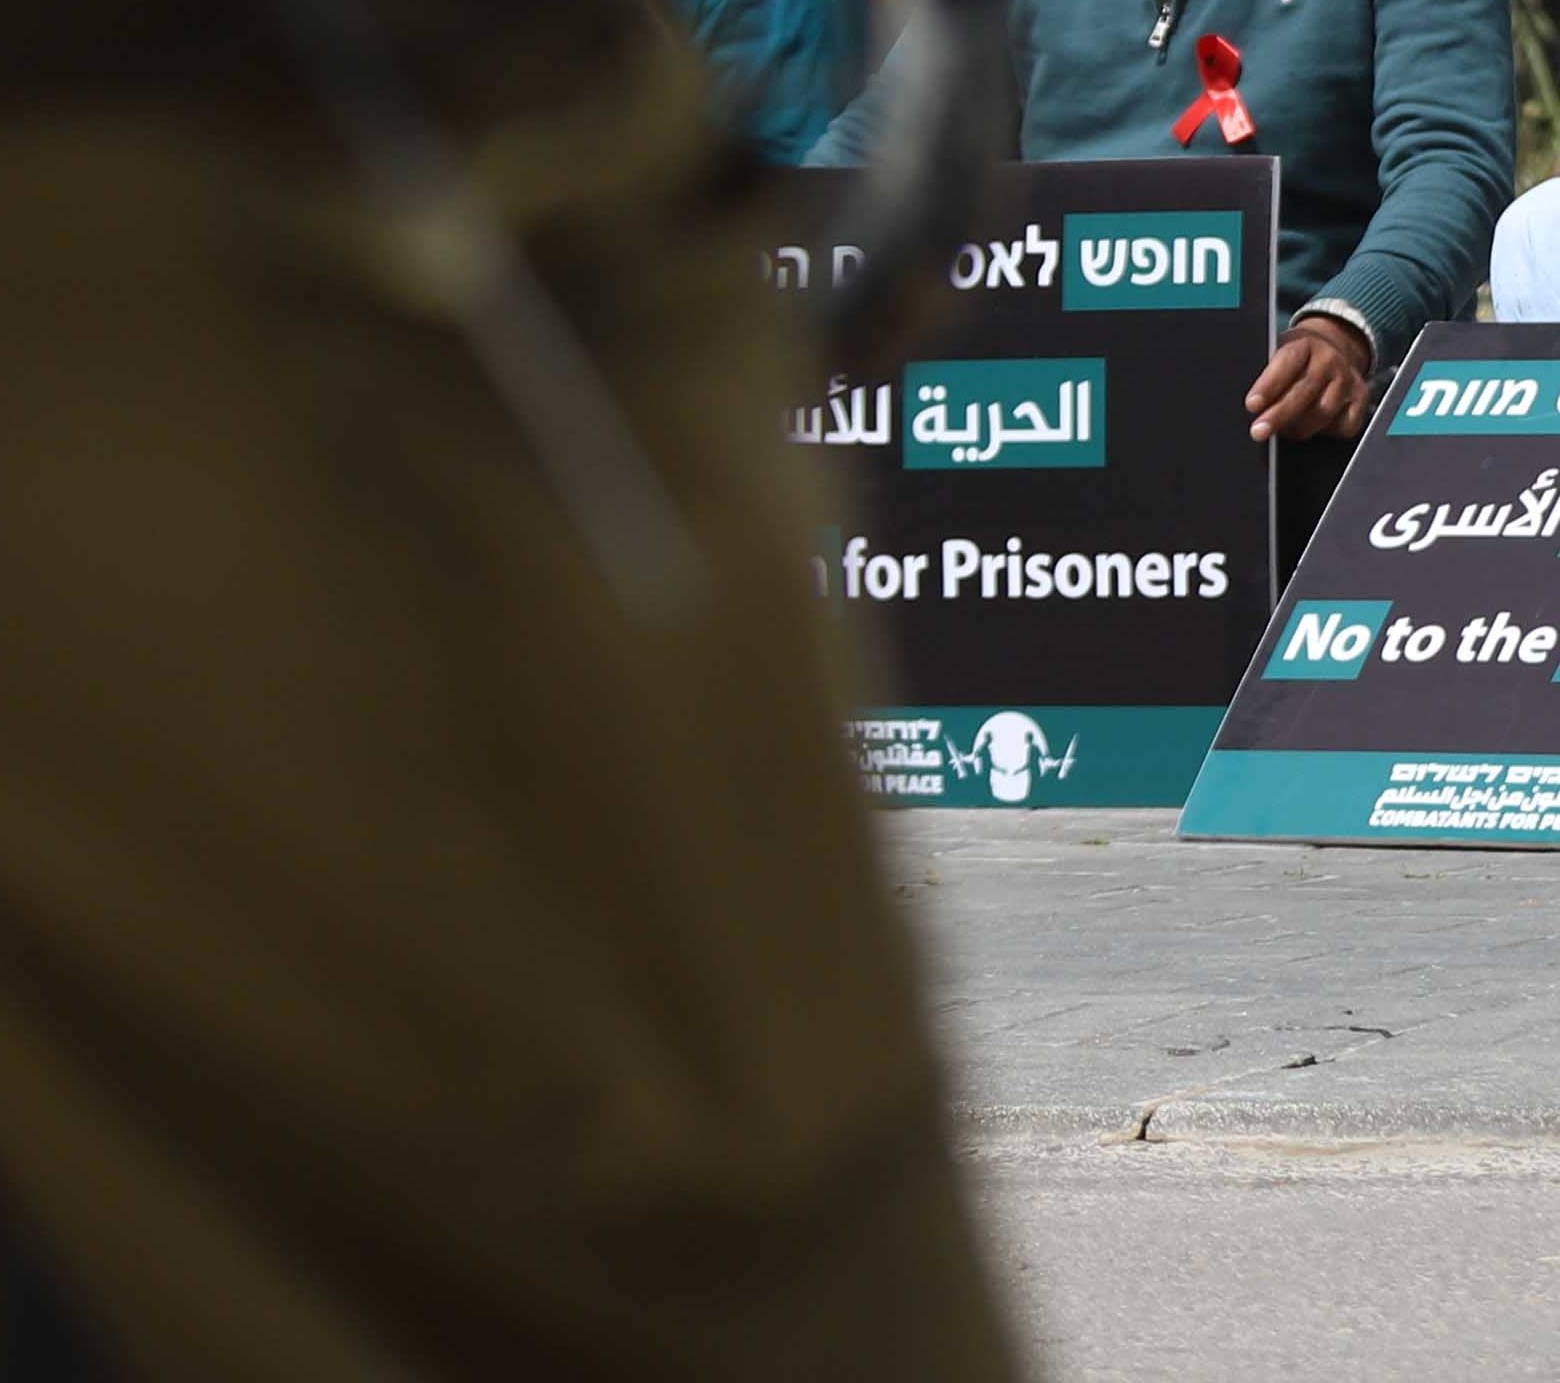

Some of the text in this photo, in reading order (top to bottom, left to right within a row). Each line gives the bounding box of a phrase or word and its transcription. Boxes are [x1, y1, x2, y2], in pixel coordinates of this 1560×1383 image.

[1080, 236, 1232, 287] חופש
[1406, 376, 1538, 418] מוות
[912, 380, 1090, 463] الحرية
[842, 536, 929, 601] for
[942, 536, 1229, 601] Prisoners
[1284, 614, 1374, 663] No
[1380, 616, 1445, 663] to
[1455, 611, 1557, 664] the
[889, 775, 945, 794] PEACE
[1390, 763, 1503, 782] לשלום
[1370, 808, 1499, 829] COMBATANTS
[1499, 812, 1541, 830] FOR
